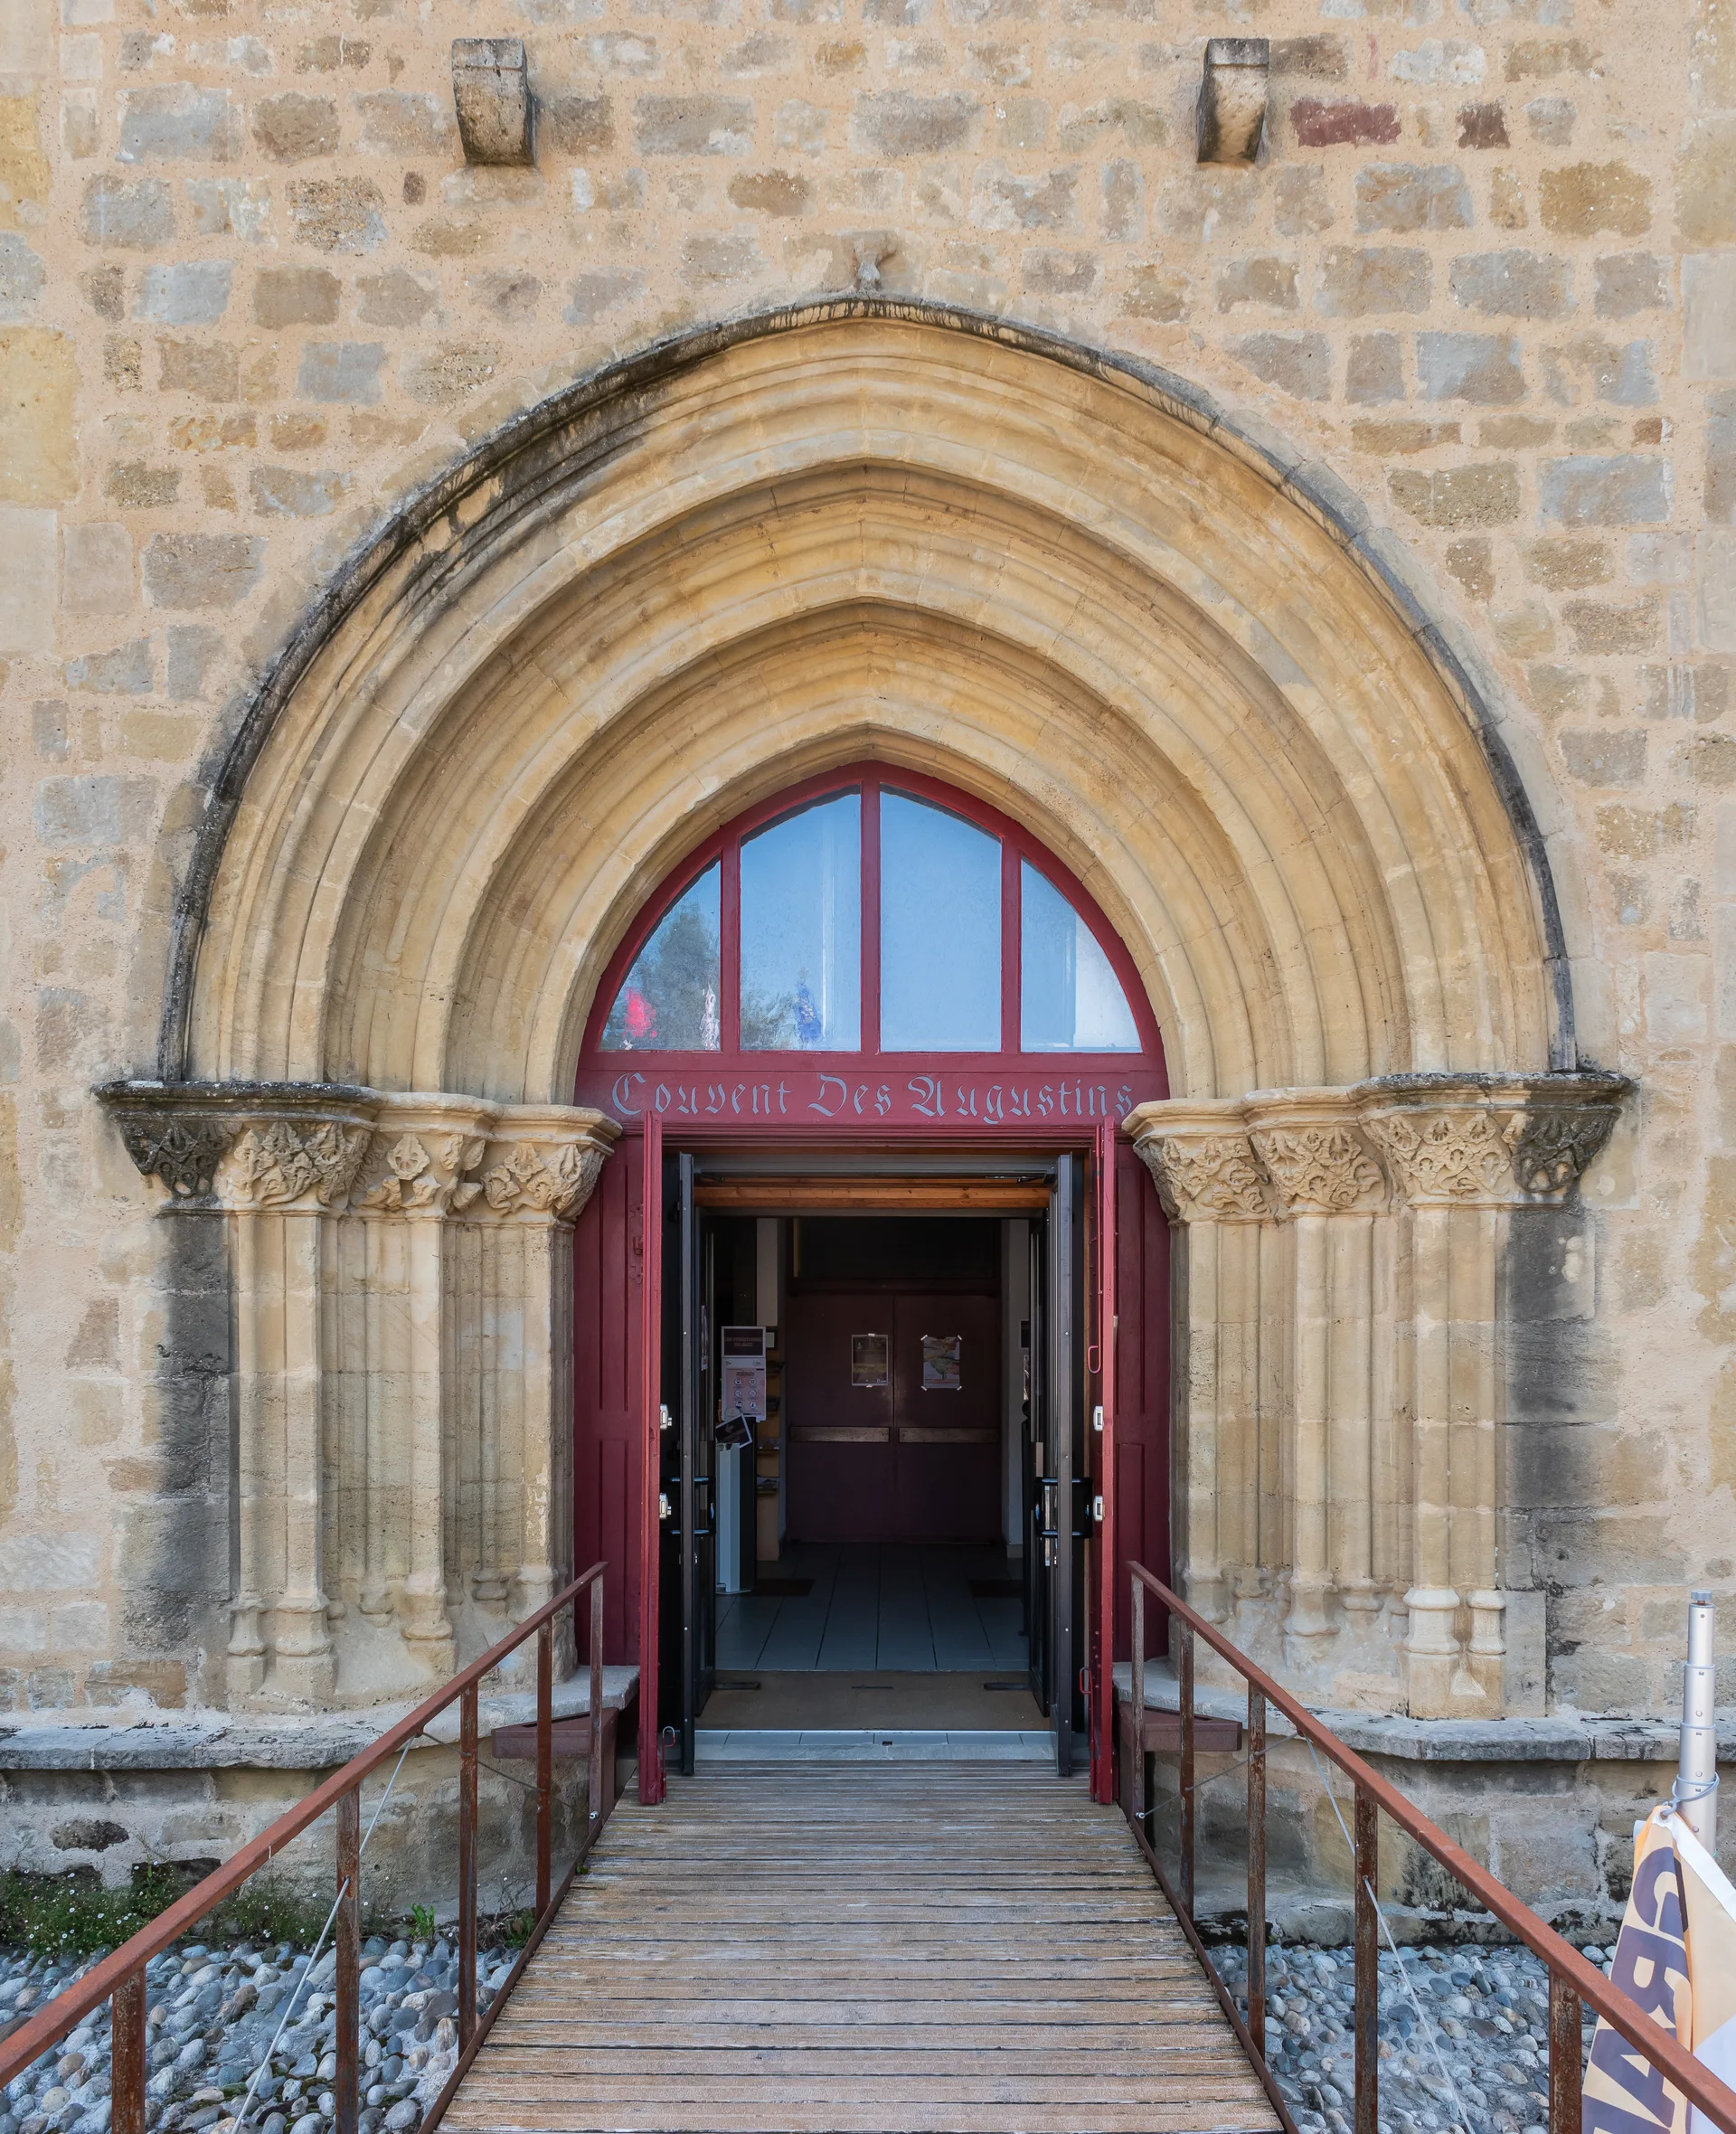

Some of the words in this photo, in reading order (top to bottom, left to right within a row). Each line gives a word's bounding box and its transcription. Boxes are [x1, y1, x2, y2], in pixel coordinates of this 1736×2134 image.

[611, 1072, 792, 1115] Couvent
[807, 1073, 892, 1118] Des
[907, 1076, 1133, 1125] Augustins
